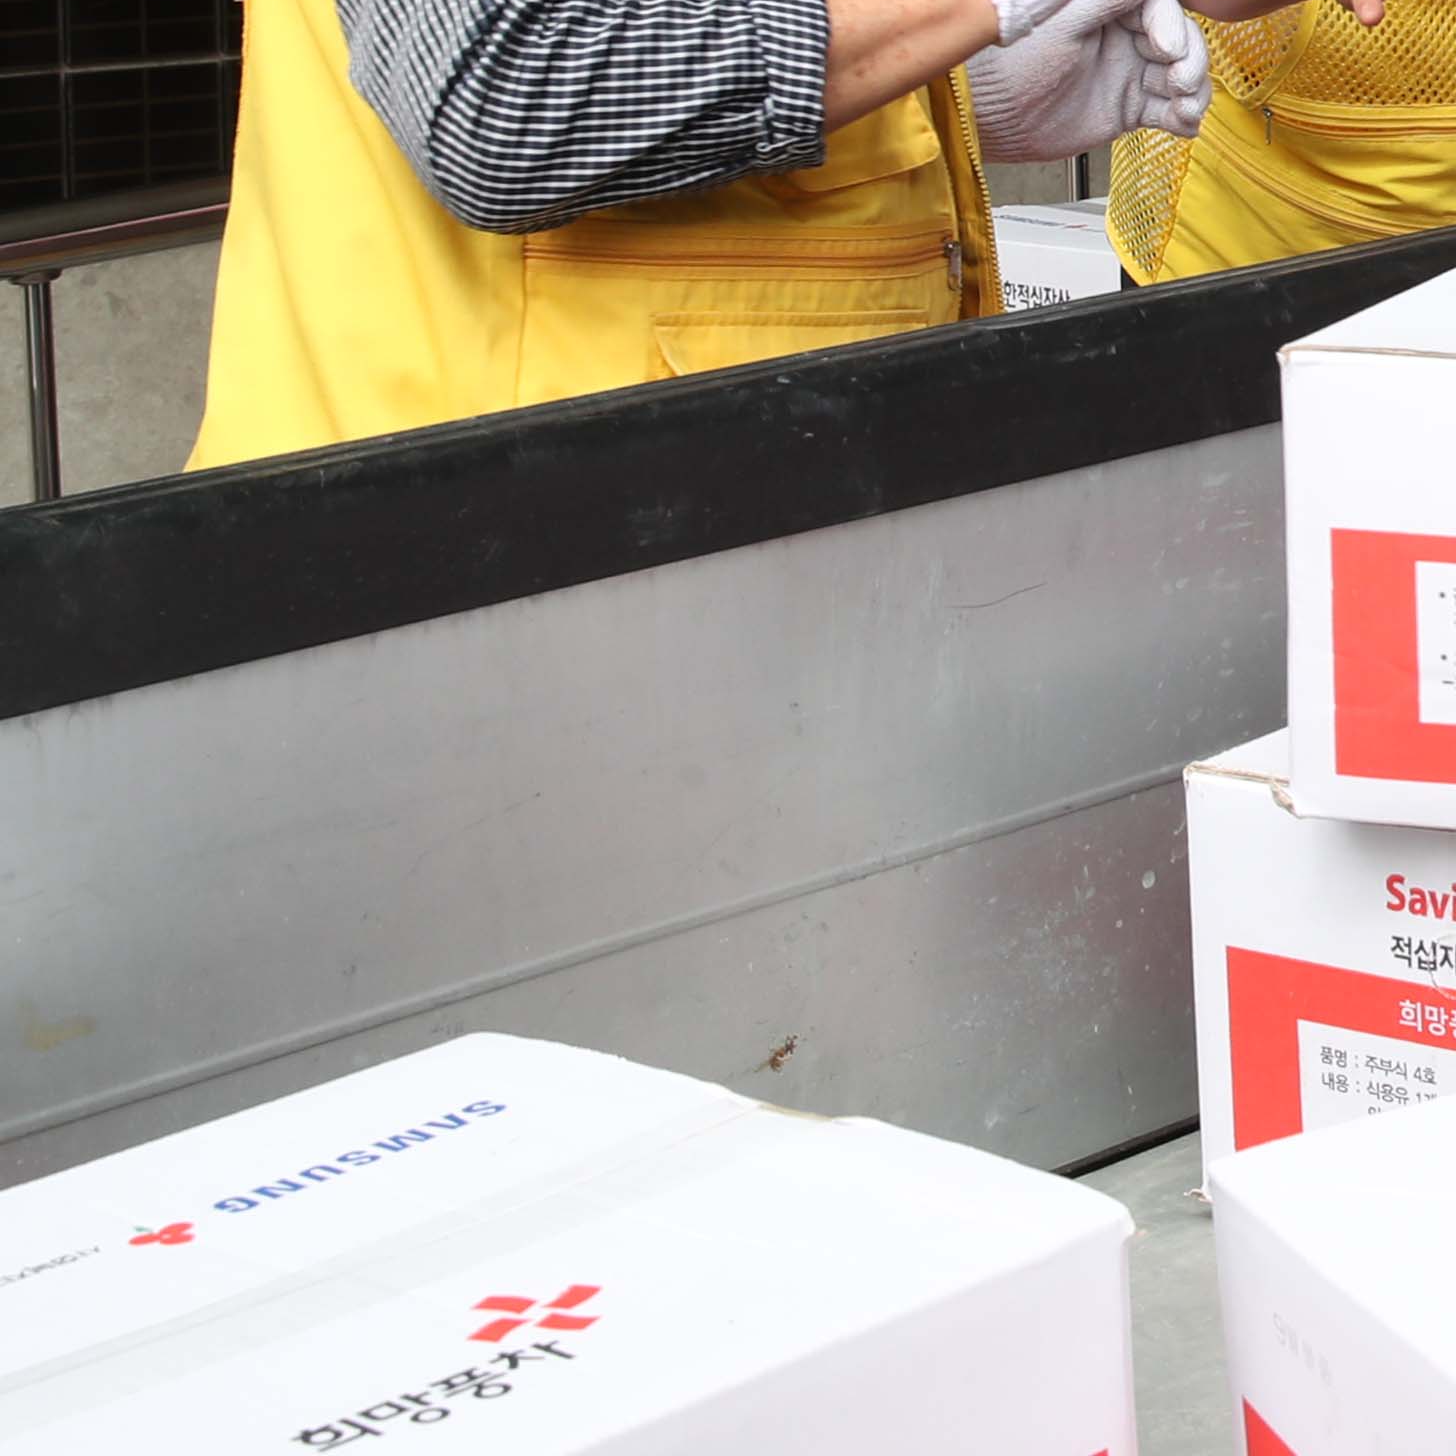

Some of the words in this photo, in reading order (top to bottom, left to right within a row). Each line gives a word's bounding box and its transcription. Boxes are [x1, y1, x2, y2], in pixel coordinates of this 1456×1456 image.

[1320, 1046, 1347, 1068] 품명
[1365, 1055, 1409, 1083] 주부식
[1413, 1065, 1437, 1086] 4호
[1322, 1072, 1349, 1094] 내용
[1367, 1081, 1409, 1106] 식용유
[213, 1100, 507, 1213] SAMSUNG
[291, 1339, 576, 1452] 희망풍차
